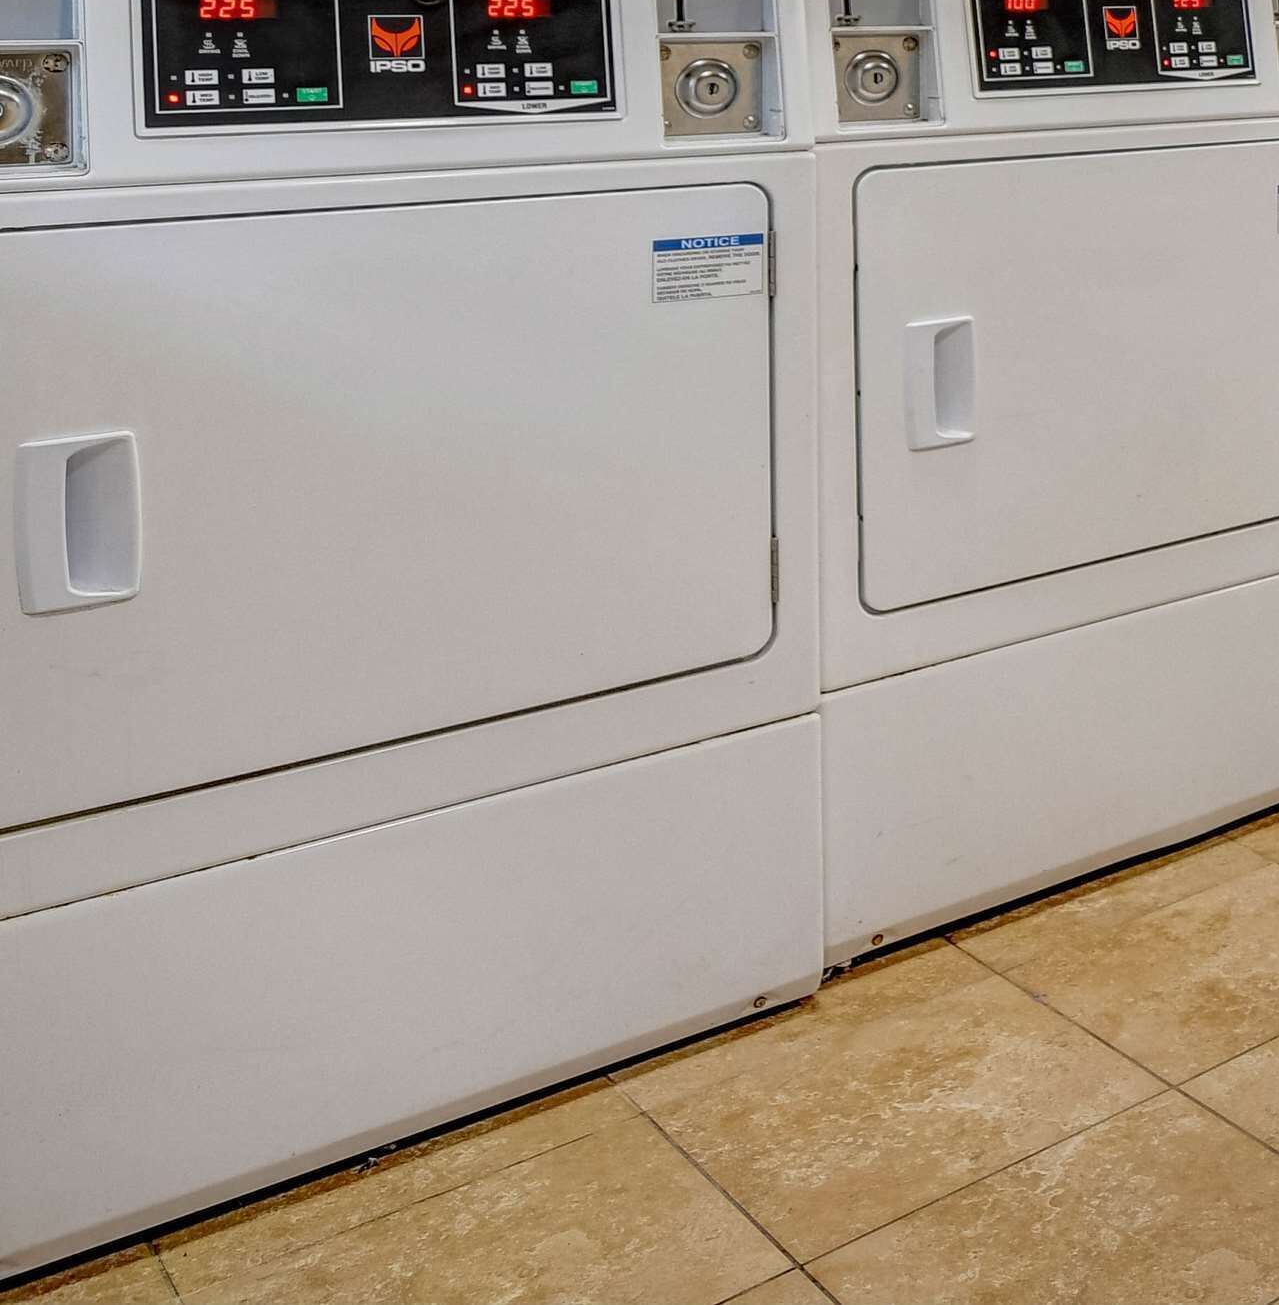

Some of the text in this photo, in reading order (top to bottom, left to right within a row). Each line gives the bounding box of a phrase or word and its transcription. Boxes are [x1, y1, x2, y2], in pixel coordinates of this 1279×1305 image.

[1106, 40, 1140, 50] IPSO
[370, 60, 426, 73] IPSO
[521, 102, 548, 110] LOWER
[680, 236, 740, 249] NOTICE
